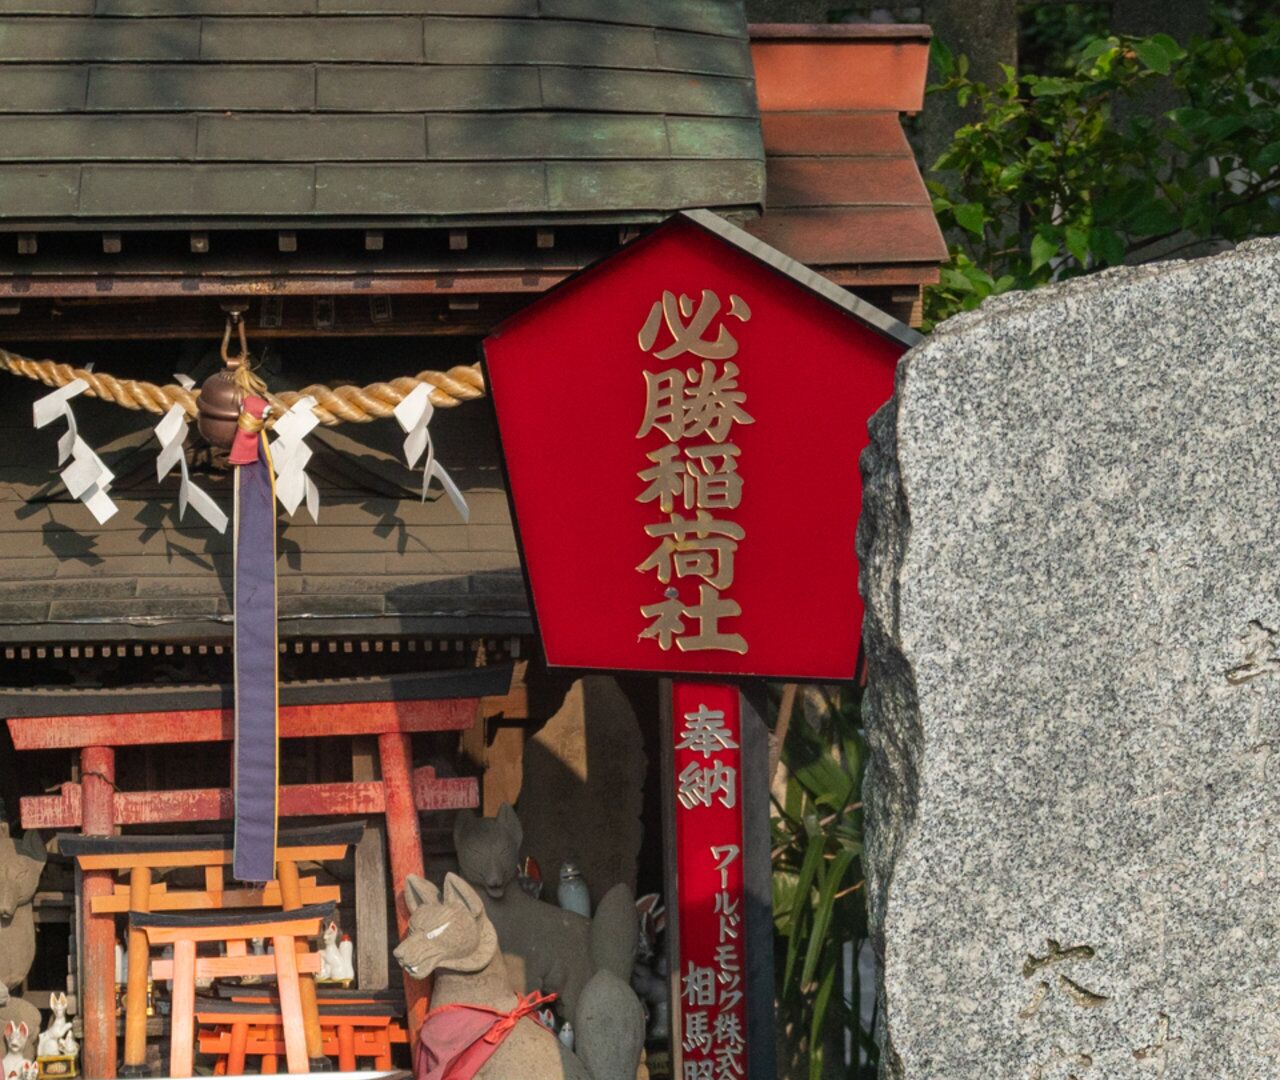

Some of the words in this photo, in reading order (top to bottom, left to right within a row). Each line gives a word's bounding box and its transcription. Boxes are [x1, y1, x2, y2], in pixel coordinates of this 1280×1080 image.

[635, 289, 755, 656] 必勝稲荷社
[674, 704, 740, 809] 奉納
